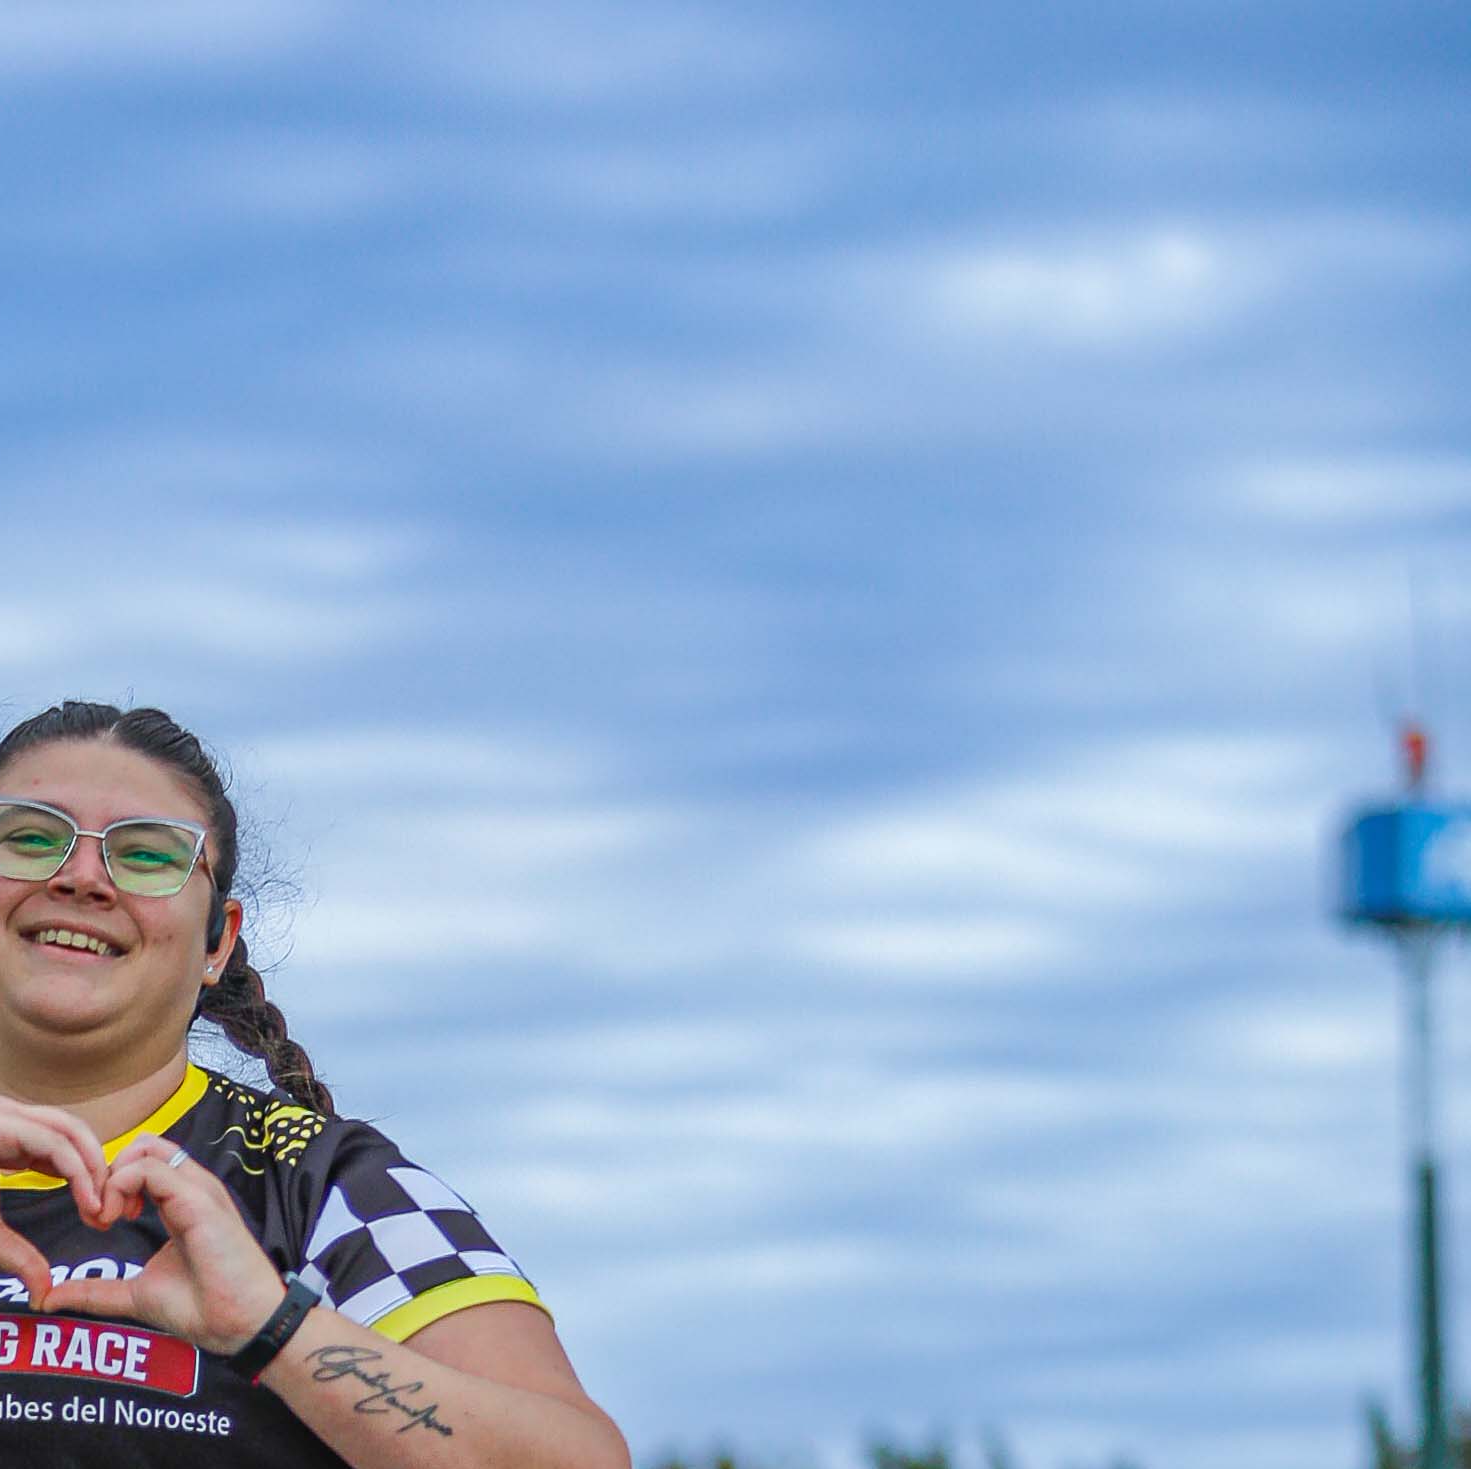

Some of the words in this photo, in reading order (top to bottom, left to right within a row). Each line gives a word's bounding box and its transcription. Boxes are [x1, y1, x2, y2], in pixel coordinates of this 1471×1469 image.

[30, 1323, 151, 1382] RACE
[61, 1396, 106, 1424] del
[114, 1399, 231, 1436] Noroeste
